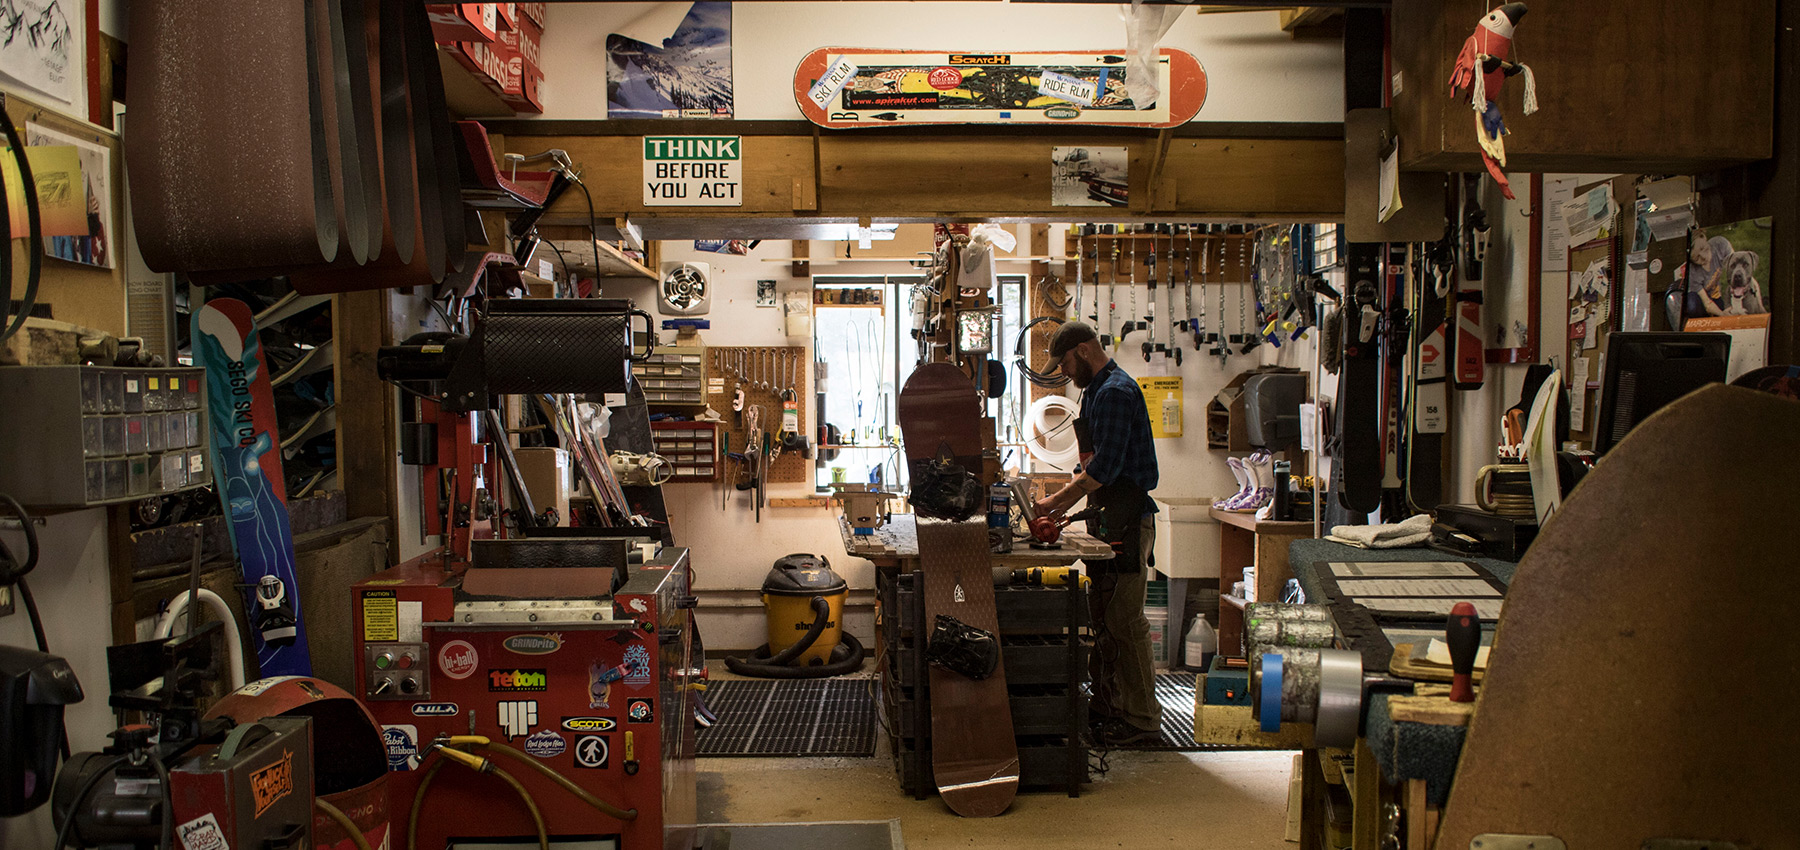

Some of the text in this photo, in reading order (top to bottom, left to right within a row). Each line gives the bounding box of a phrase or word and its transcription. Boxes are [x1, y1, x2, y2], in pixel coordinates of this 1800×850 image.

[520, 29, 541, 67] ROSSI
[483, 46, 508, 90] ROSSI
[815, 62, 852, 103] SKI RLM
[1044, 78, 1091, 100] RIDE RLM
[852, 96, 937, 106] www.spirakut.com
[648, 140, 736, 158] THINK
[656, 163, 729, 178] BEFORE
[647, 182, 738, 198] YOU ACT
[1686, 319, 1711, 328] MARCH
[227, 361, 249, 396] SEGO
[234, 400, 253, 427] SKI
[1426, 406, 1438, 414] 158
[511, 638, 555, 649] GRINDrite
[490, 669, 546, 687] teton
[570, 720, 608, 728] SCOTT
[383, 732, 405, 746] Pabst
[391, 745, 416, 755] Ribbon
